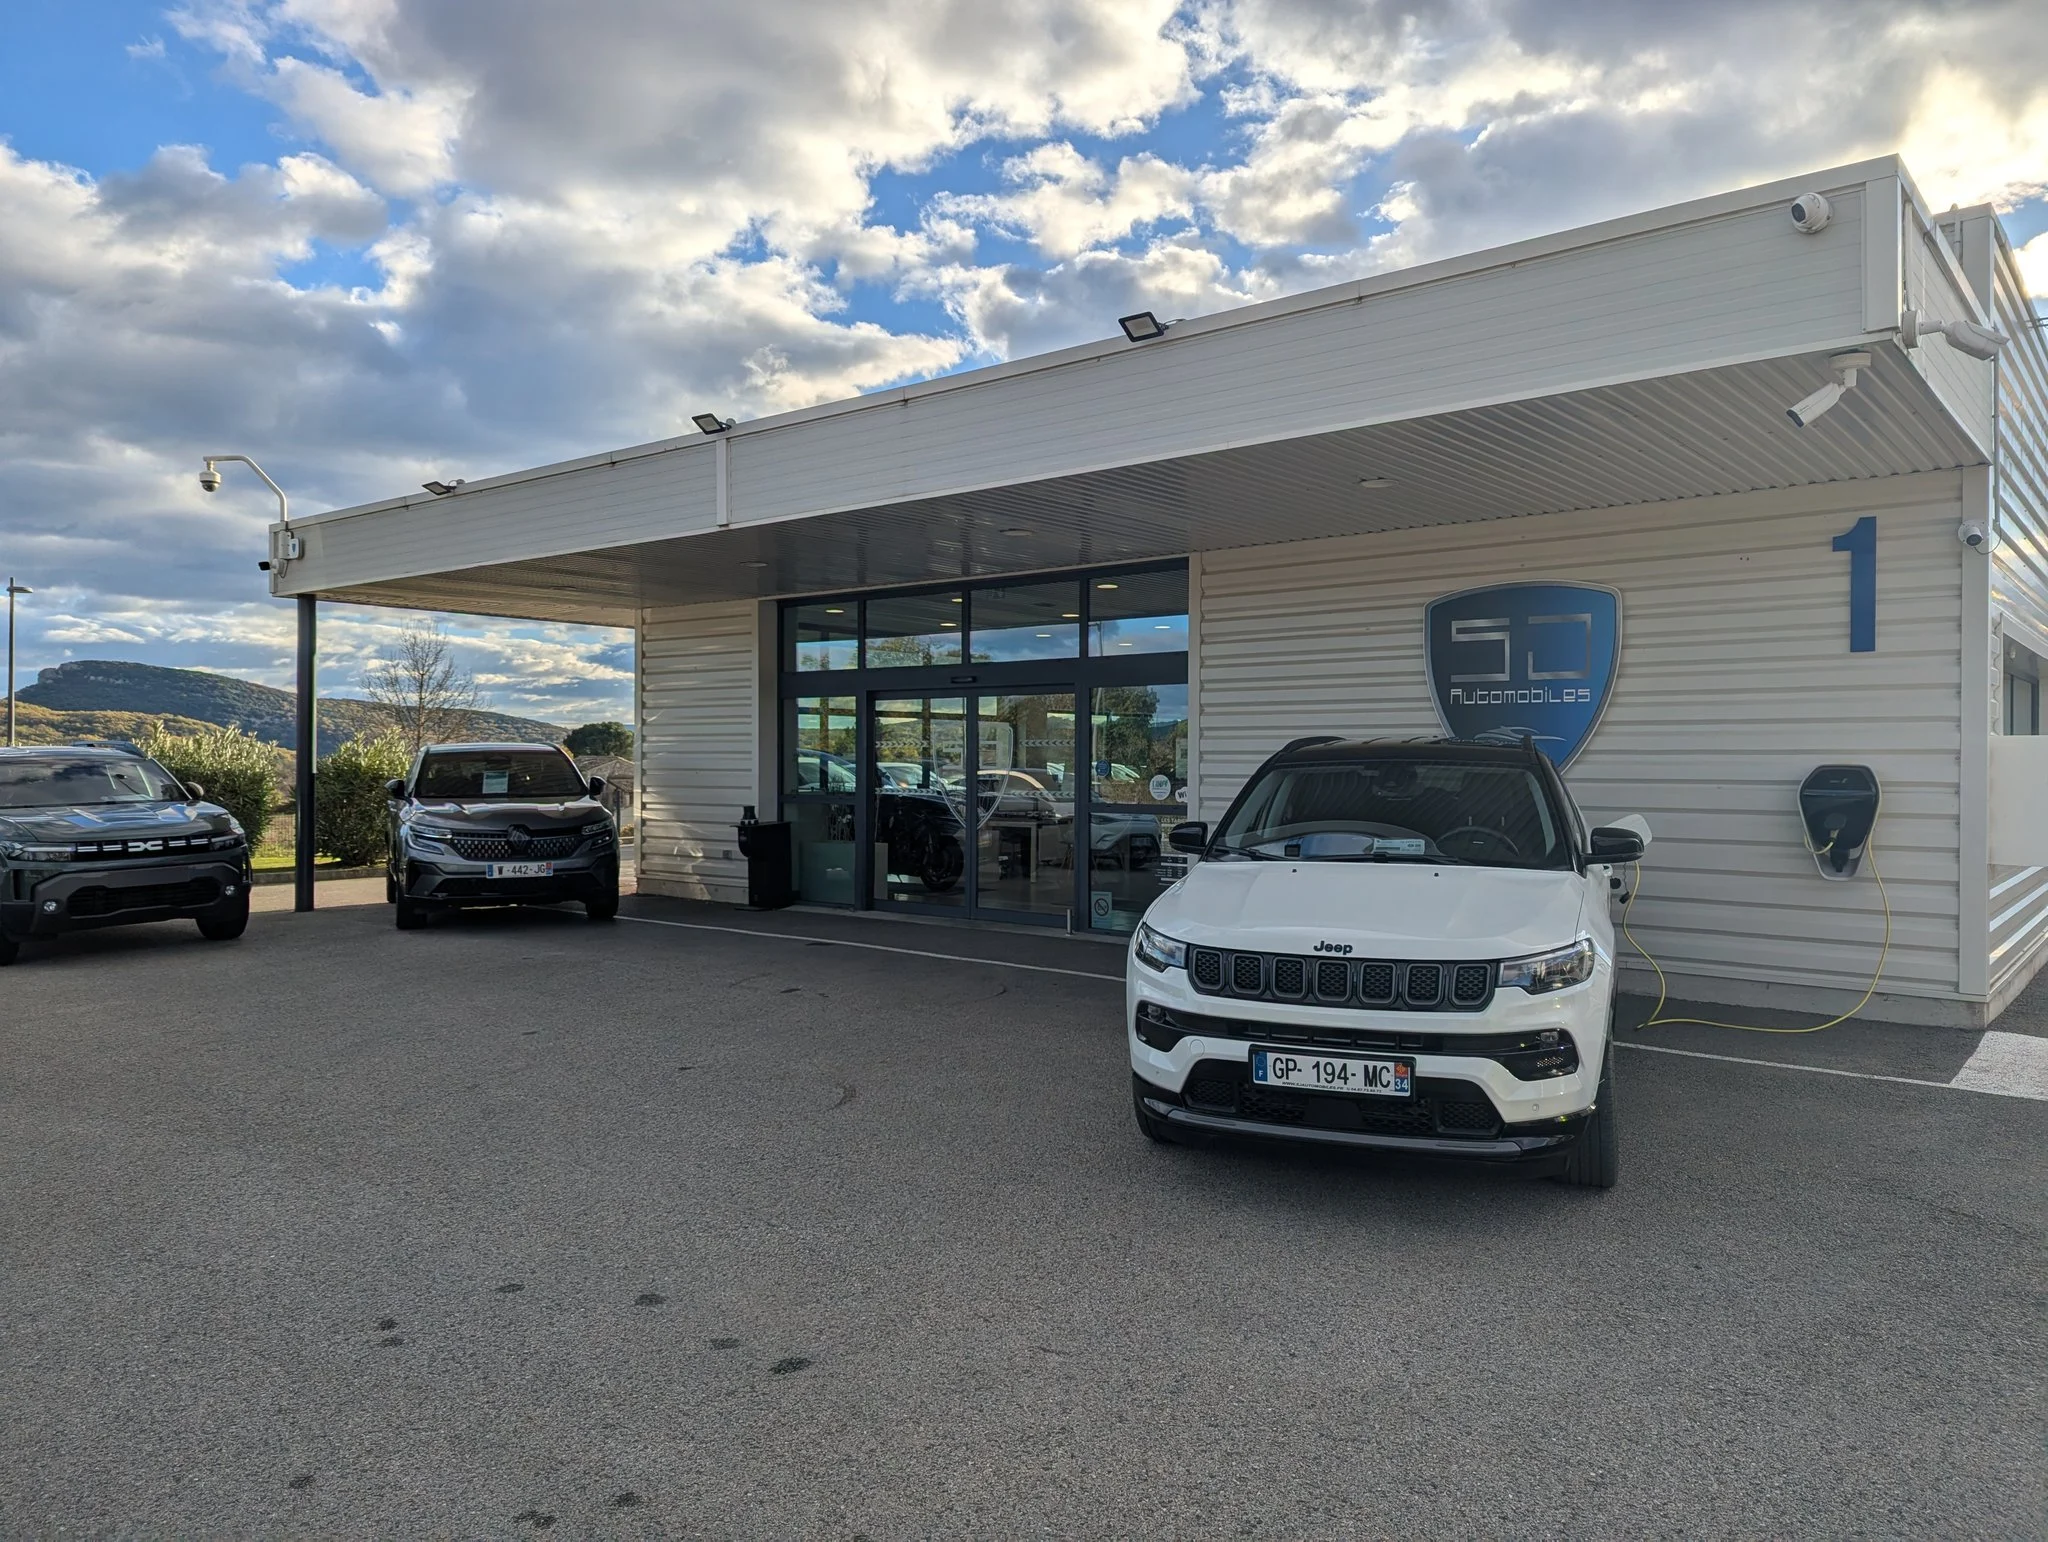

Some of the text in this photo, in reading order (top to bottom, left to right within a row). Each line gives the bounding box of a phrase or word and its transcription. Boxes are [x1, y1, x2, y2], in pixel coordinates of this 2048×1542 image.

[1832, 516, 1877, 652] 1
[1313, 940, 1353, 955] Jeep
[1395, 1078, 1409, 1091] 34
